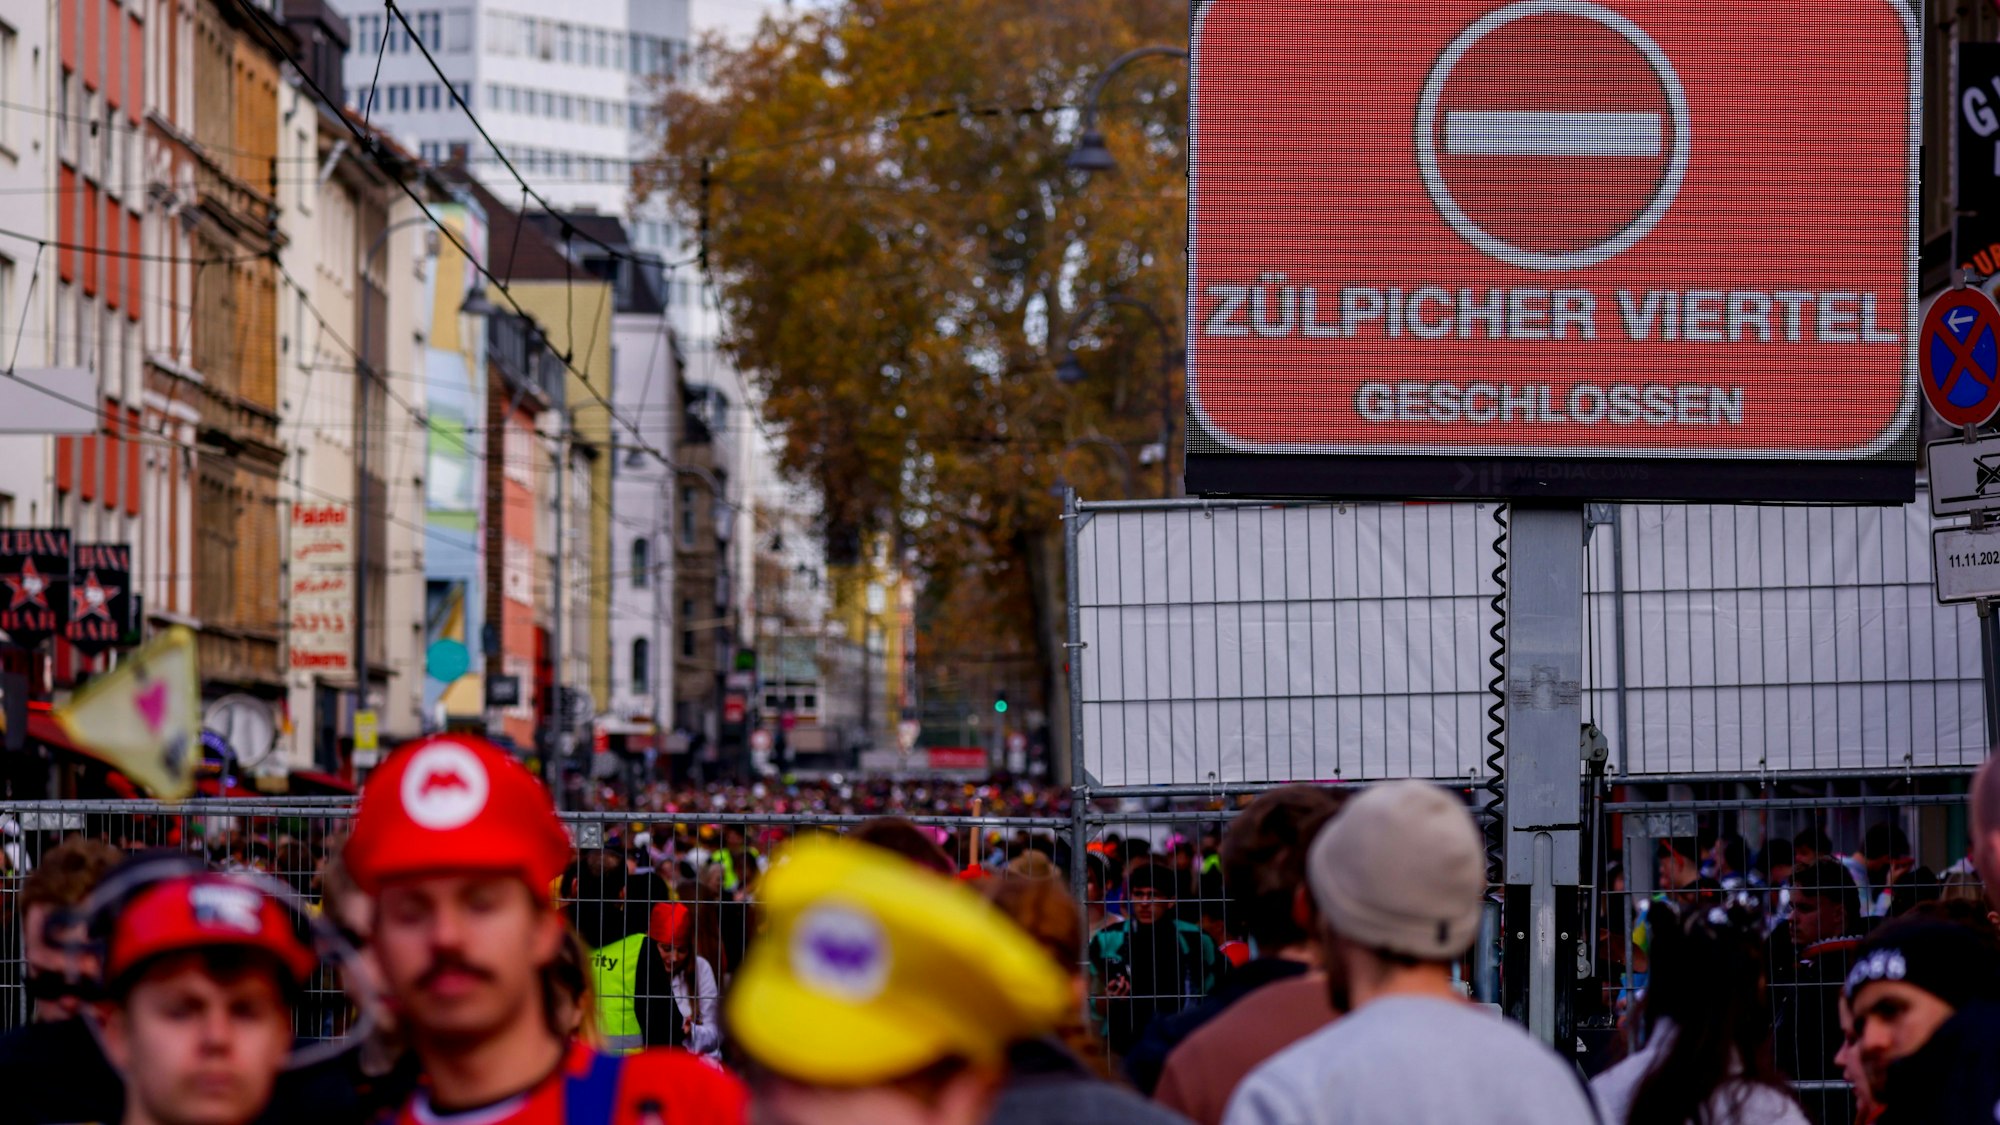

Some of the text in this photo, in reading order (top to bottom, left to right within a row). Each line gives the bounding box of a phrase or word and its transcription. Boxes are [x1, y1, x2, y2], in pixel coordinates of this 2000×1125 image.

[1204, 272, 1899, 343] ZÜLPICHER VIERTEL
[1355, 380, 1745, 425] GESCHLOSSEN
[1, 608, 57, 632] BAR
[65, 618, 119, 641] BAR
